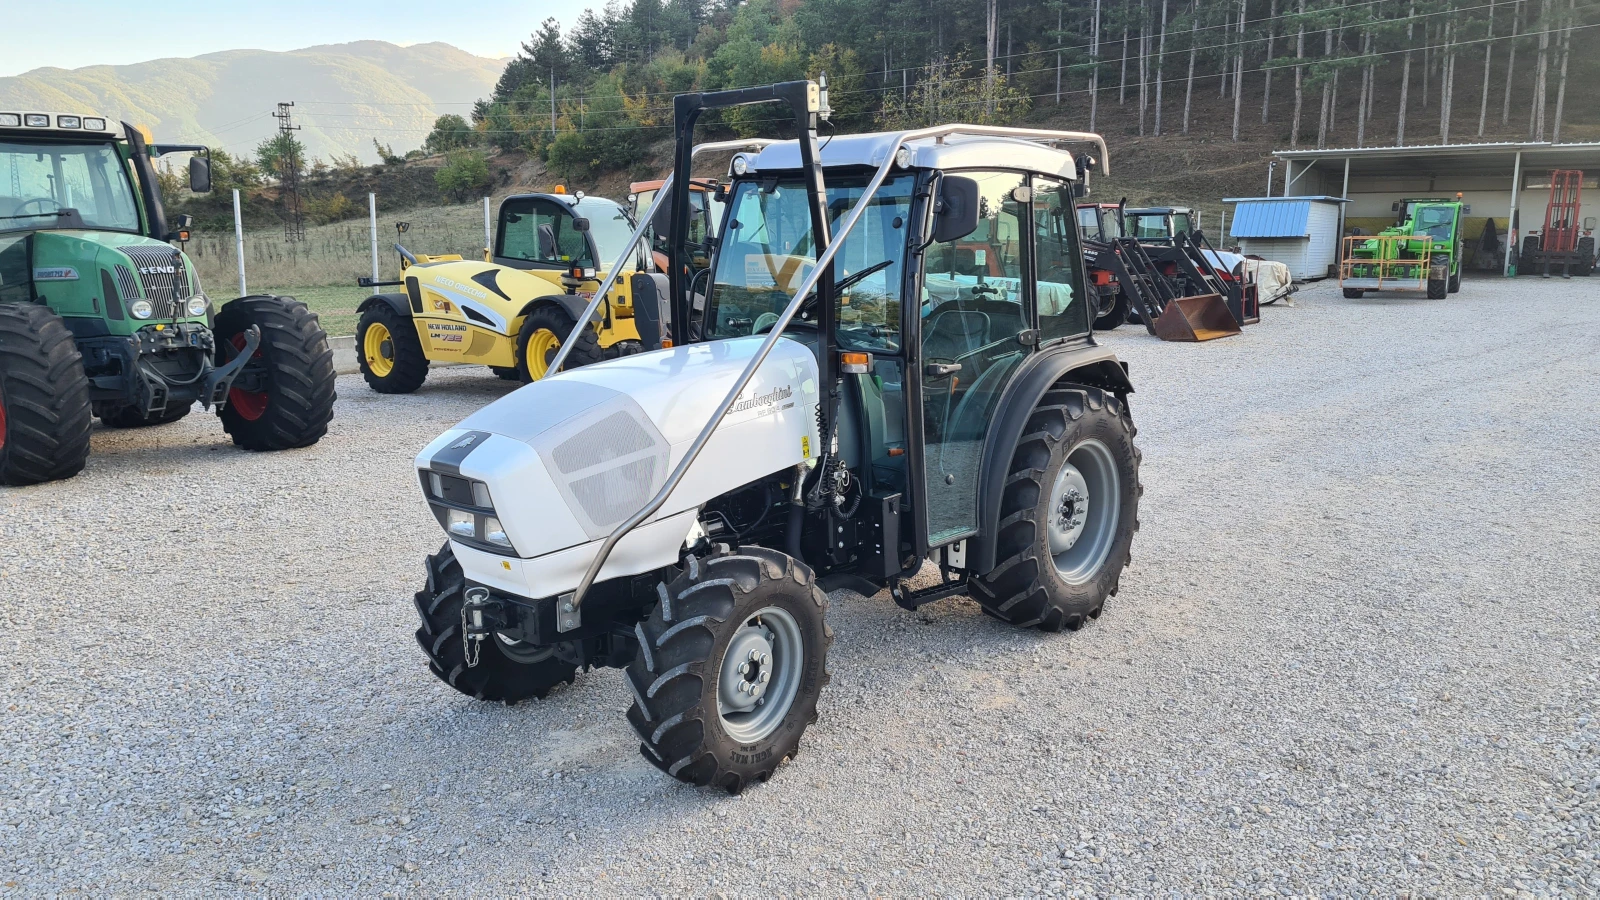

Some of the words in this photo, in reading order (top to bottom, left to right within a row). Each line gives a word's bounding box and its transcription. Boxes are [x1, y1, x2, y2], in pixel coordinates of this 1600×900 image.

[434, 275, 455, 287] IVECO
[454, 282, 487, 299] ORECCHIA
[440, 324, 467, 332] HOLLAND
[726, 384, 793, 415] Lamborghini
